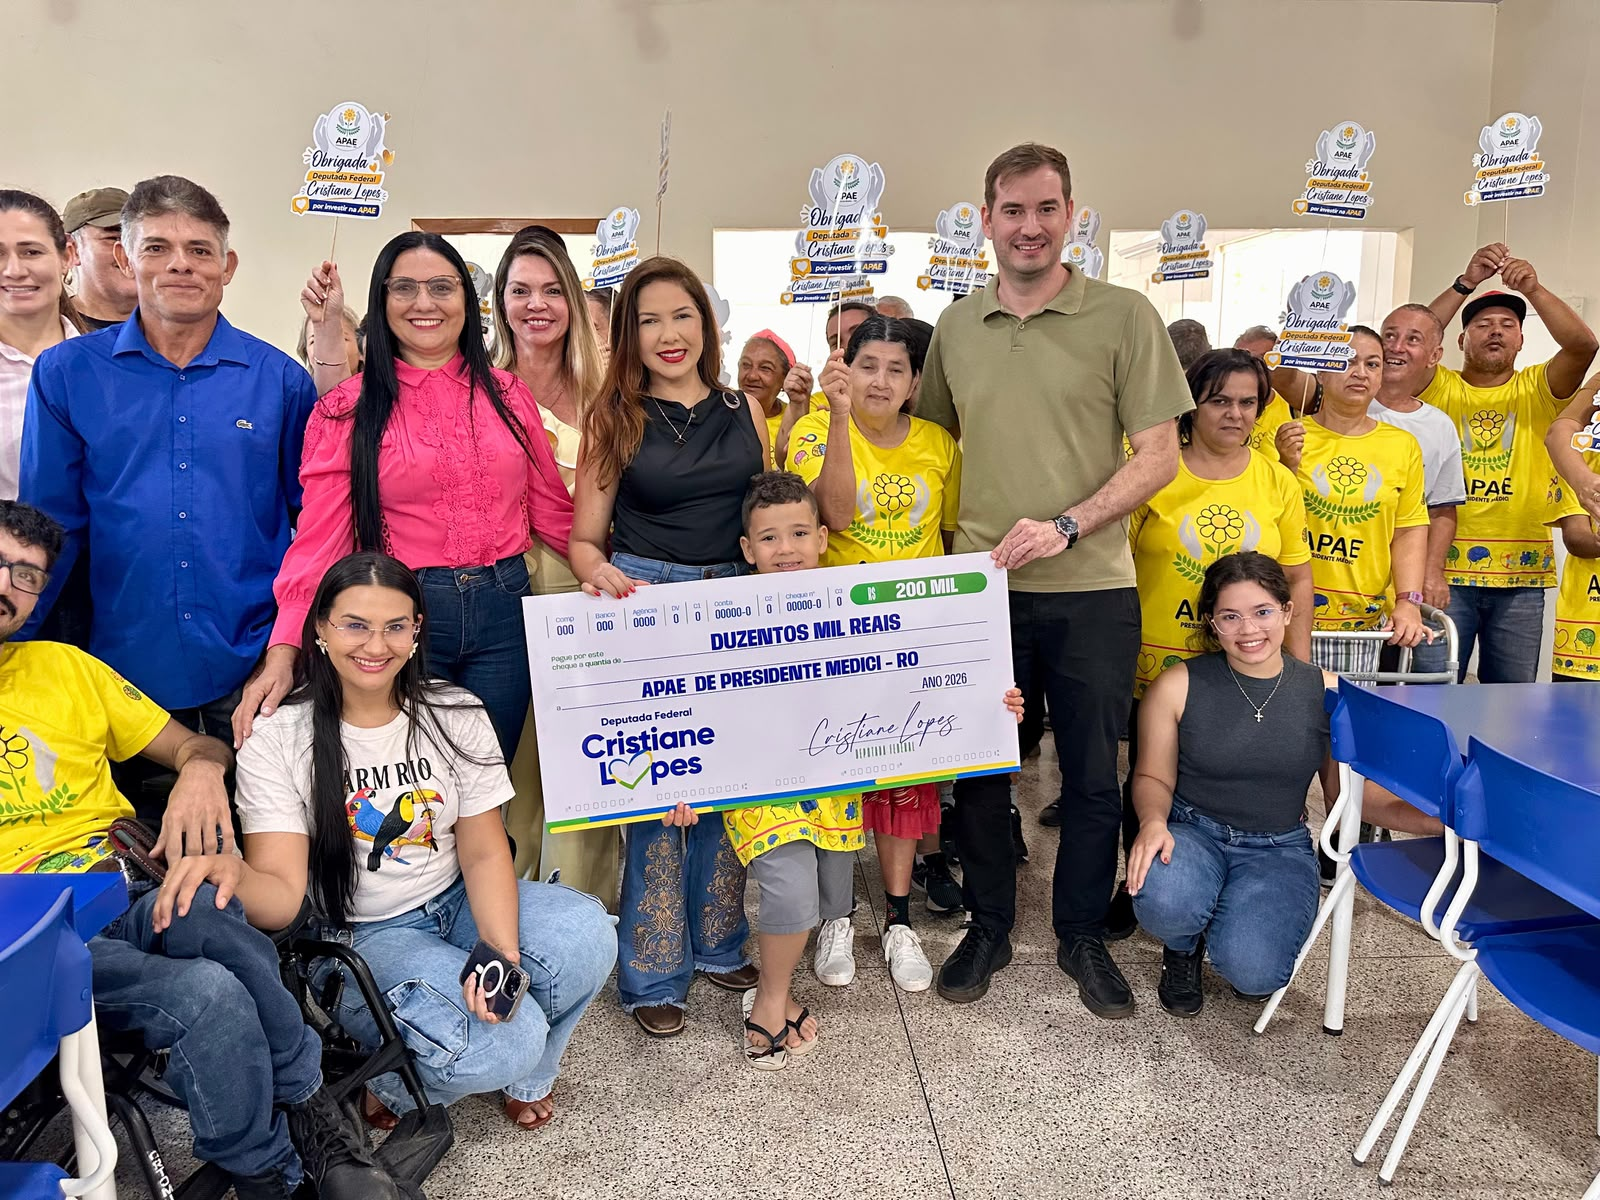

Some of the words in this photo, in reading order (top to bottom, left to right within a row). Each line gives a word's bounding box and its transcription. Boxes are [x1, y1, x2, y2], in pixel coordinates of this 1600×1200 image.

[336, 137, 358, 146] APAE
[1500, 139, 1519, 147] APAE
[312, 150, 368, 173] Obrigada
[1334, 151, 1352, 159] APAE
[1480, 148, 1529, 168] Obrigada
[312, 172, 347, 181] Deputada
[348, 175, 377, 183] Federal
[1312, 161, 1359, 181] Obrigada
[1481, 167, 1513, 177] Deputada
[1513, 163, 1538, 172] Federal
[1312, 180, 1341, 188] Deputada
[1478, 177, 1517, 190] Cristiane
[1519, 171, 1543, 185] Lopes
[307, 181, 352, 198] Cristiane
[352, 183, 381, 201] Lopes
[835, 191, 858, 200] PAE
[1306, 187, 1344, 201] Cristiane
[1344, 190, 1368, 204] Lopes
[312, 202, 324, 210] por
[324, 203, 348, 212] investir
[357, 206, 377, 214] APAE
[810, 205, 866, 230] Obrigad
[953, 230, 970, 238] APAE
[807, 240, 855, 258] Cristiane
[1162, 240, 1199, 254] Obrigada
[814, 264, 828, 273] por
[828, 263, 852, 271] investir
[862, 262, 883, 270] APAE
[791, 280, 824, 292] Cristiane
[1309, 301, 1331, 309] APAE
[1285, 313, 1339, 333] Obrigada
[1285, 332, 1318, 340] Deputada
[1279, 339, 1322, 354] Cristiane
[1322, 341, 1350, 357] Lopes
[1295, 358, 1317, 366] investir
[895, 580, 927, 599] 200
[930, 577, 959, 595] MIL
[555, 616, 575, 624] Comp
[785, 592, 808, 601] Cheque
[556, 624, 575, 636] 000
[596, 620, 614, 632] 000
[633, 616, 656, 628] 0000
[673, 613, 680, 624] 0
[695, 611, 701, 622] 0
[715, 606, 752, 619] 00000-0
[766, 603, 773, 614] 0
[786, 598, 822, 612] 00000-0
[836, 596, 843, 606] 0
[710, 623, 809, 650] DUZENTOS
[813, 620, 846, 639] MIL
[849, 613, 901, 635] REAIS
[551, 655, 573, 664] Pague
[573, 653, 587, 661] por
[588, 651, 604, 659] este
[552, 662, 578, 671] cheque
[584, 658, 611, 669] quantia
[642, 678, 687, 698] APAE
[695, 674, 716, 693] DE
[720, 663, 822, 690] PRESIDENTE
[825, 655, 882, 677] MEDICI
[896, 651, 919, 668] RO
[922, 675, 943, 689] ANO
[944, 672, 968, 686] 2026
[601, 712, 652, 727] Deputada
[654, 707, 692, 720] Federal
[808, 713, 899, 757] Cristiane
[899, 701, 958, 747] Lopes
[581, 726, 715, 759] Cristiane
[343, 765, 391, 793] ARM
[394, 757, 432, 786] RIO
